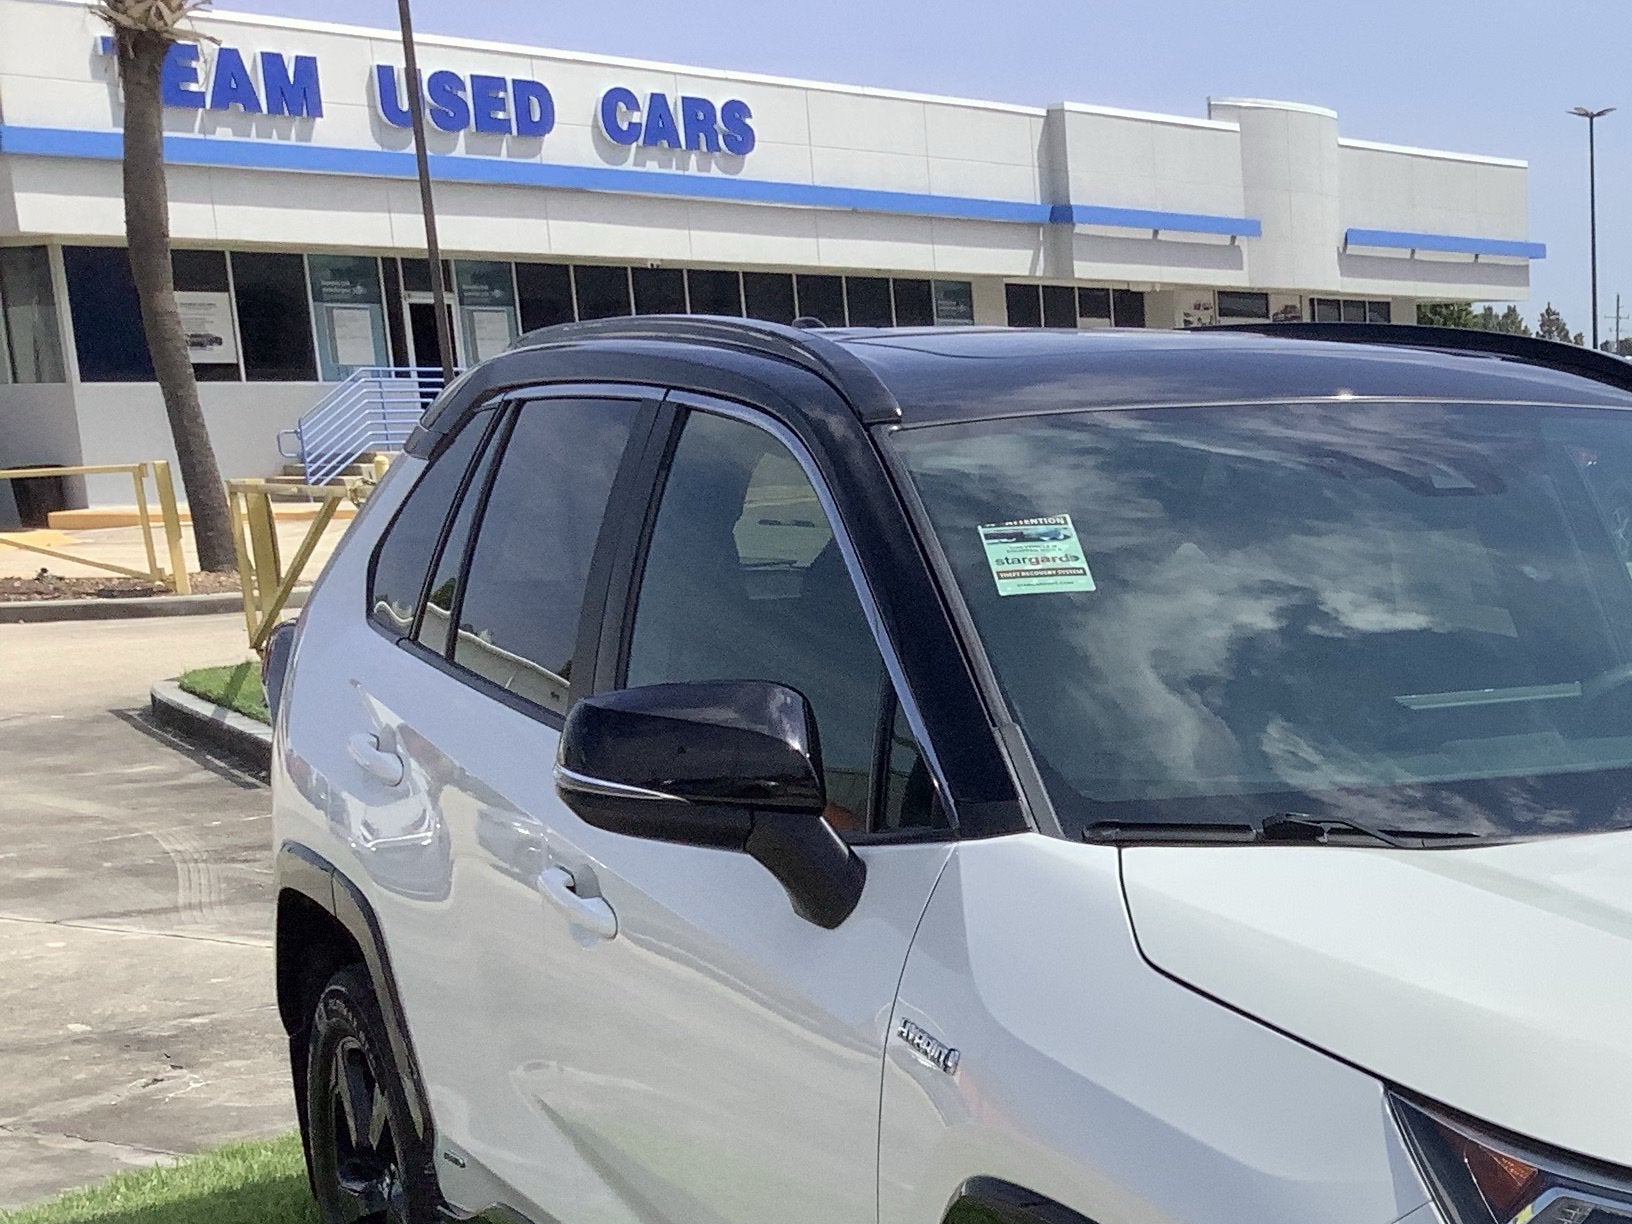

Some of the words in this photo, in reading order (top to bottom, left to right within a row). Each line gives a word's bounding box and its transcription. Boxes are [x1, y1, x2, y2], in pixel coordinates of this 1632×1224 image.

[101, 36, 323, 118] EAM
[376, 64, 555, 137] USED
[601, 86, 756, 156] CARS
